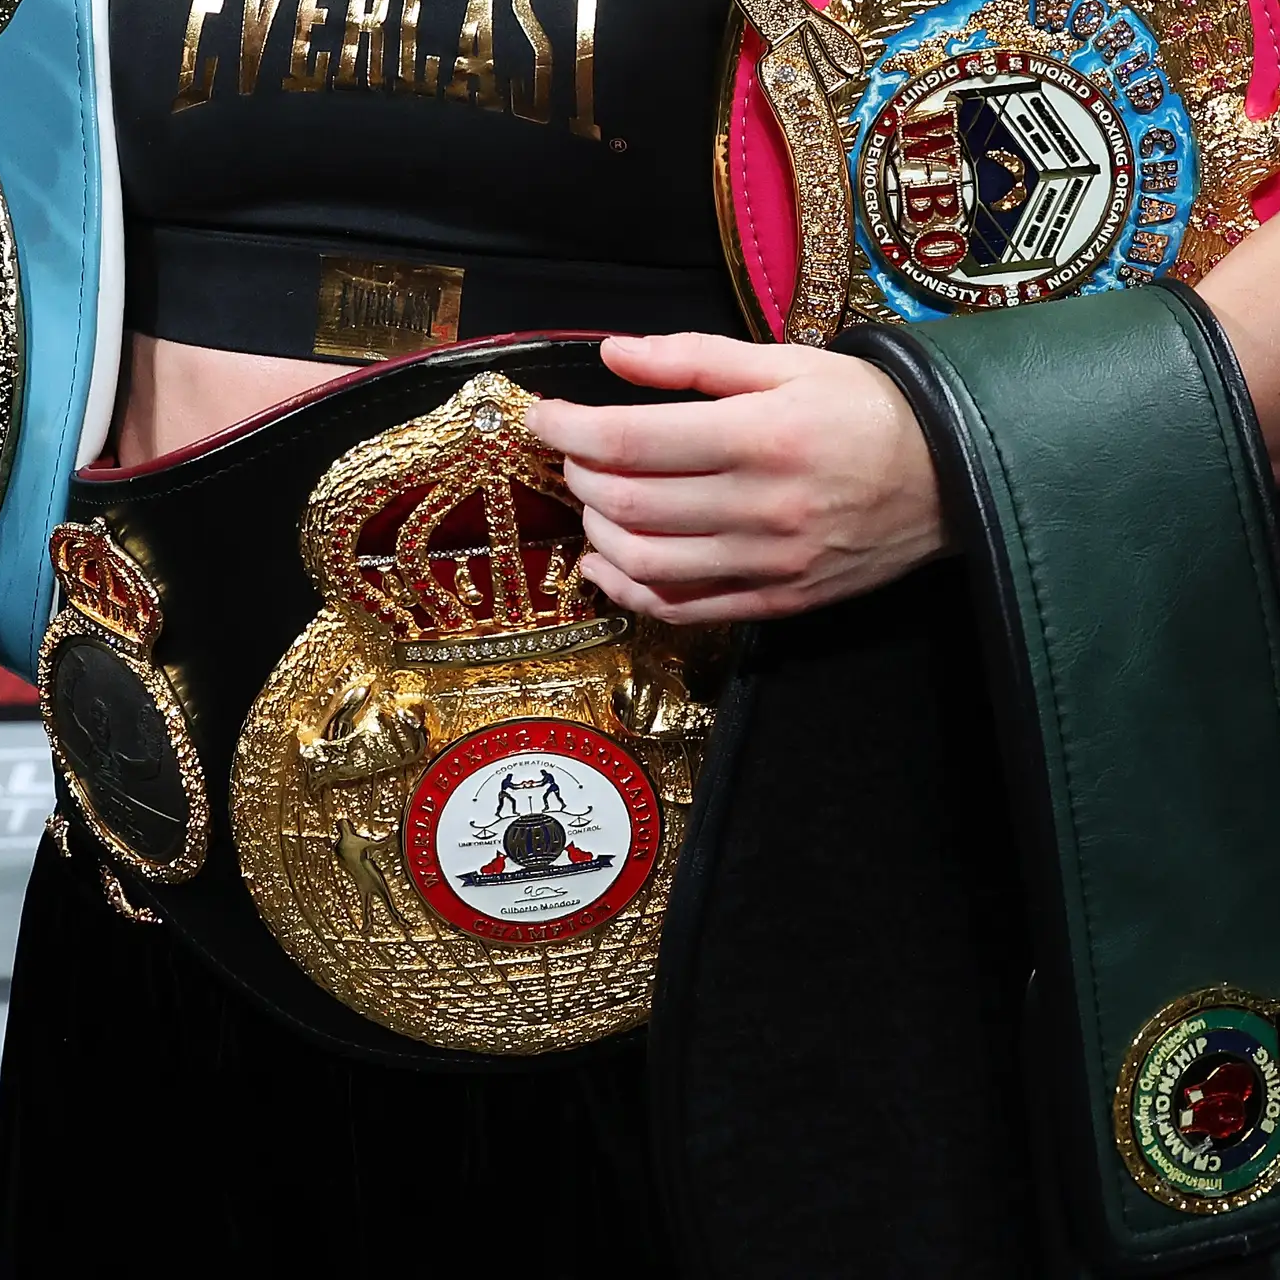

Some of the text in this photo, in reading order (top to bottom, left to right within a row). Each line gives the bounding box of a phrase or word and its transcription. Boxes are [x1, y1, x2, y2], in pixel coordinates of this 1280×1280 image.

[892, 65, 960, 120] DIGNITY
[864, 132, 894, 246] DEMOCRACY
[897, 100, 971, 272] WBO
[1029, 59, 1130, 291] WORLD BOXING ORGANIZATION
[1120, 126, 1179, 290] CHAMP
[900, 260, 983, 304] HONESTY
[414, 729, 650, 888] WORLD BOXING ASSOCIATION
[495, 759, 558, 777] COOPERATION
[566, 824, 602, 837] CONTROL
[472, 900, 612, 941] CHAMPION
[500, 904, 538, 916] Gilberto
[1154, 1036, 1222, 1172] CHAMPIONSHIP
